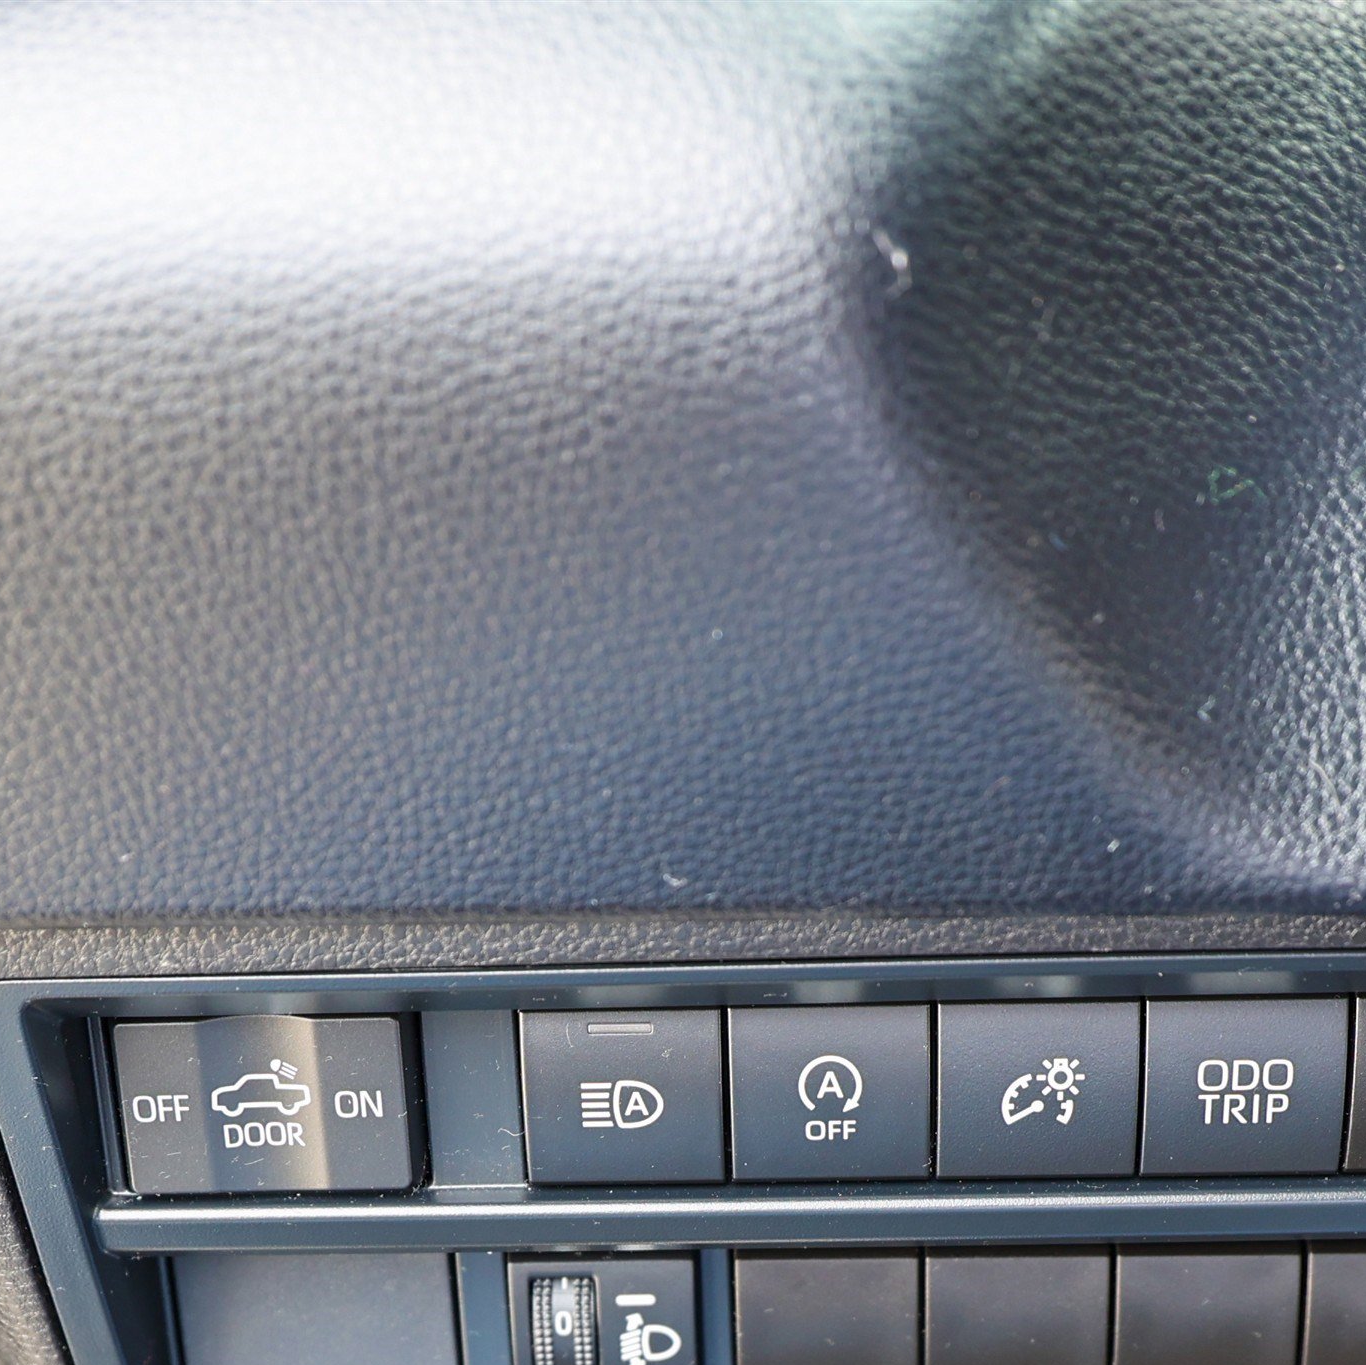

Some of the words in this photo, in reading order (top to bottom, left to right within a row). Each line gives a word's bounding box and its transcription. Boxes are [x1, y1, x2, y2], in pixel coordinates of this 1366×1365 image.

[816, 1071, 844, 1098] A
[1196, 1058, 1294, 1091] ODO
[133, 1094, 189, 1123] OFF
[334, 1090, 383, 1118] ON
[624, 1091, 648, 1116] A
[1198, 1094, 1289, 1124] TRIP
[223, 1122, 305, 1148] DOOR
[804, 1120, 856, 1141] OFF
[554, 1310, 573, 1336] 0
